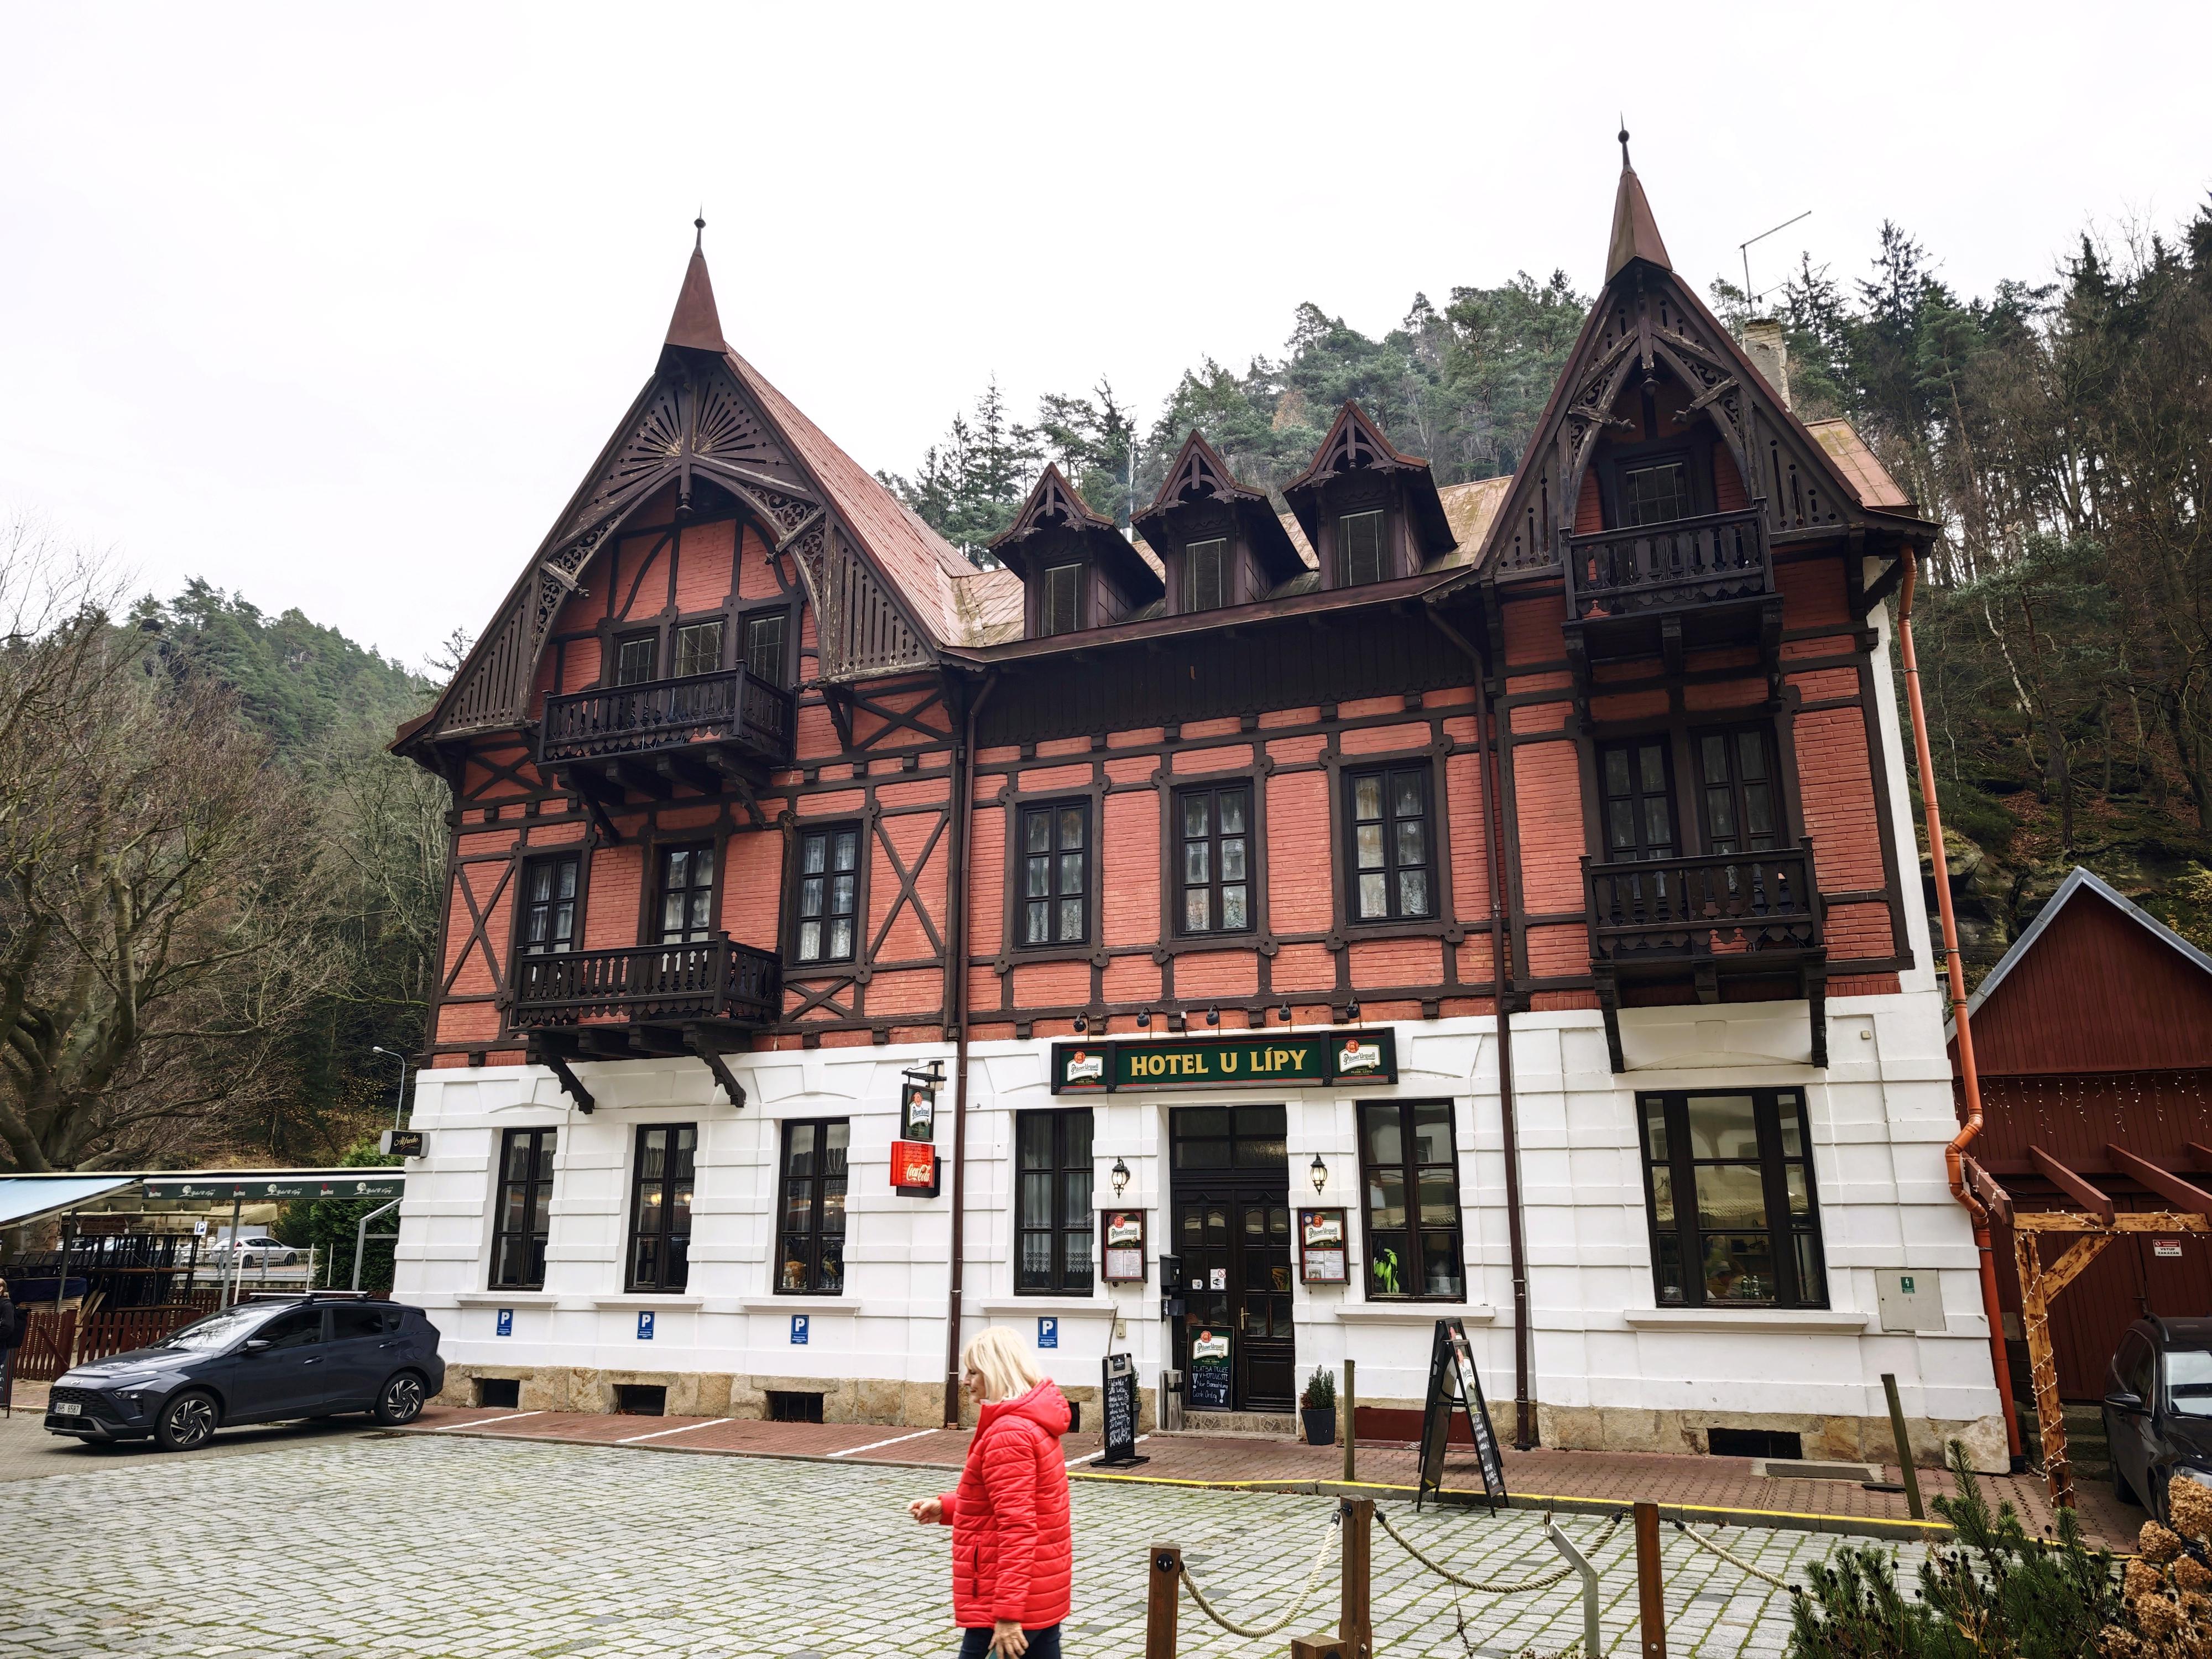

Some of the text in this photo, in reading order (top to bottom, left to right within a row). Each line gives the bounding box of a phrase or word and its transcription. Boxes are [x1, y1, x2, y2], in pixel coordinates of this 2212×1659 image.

[1130, 1047, 1307, 1077] HOTEL U LÍPY
[394, 1135, 418, 1147] Alfredo
[198, 1223, 205, 1232] P
[501, 1312, 510, 1324] P
[641, 1314, 651, 1327] P
[795, 1318, 805, 1332] P
[1042, 1320, 1053, 1334] P
[1193, 1389, 1203, 1397] Cash
